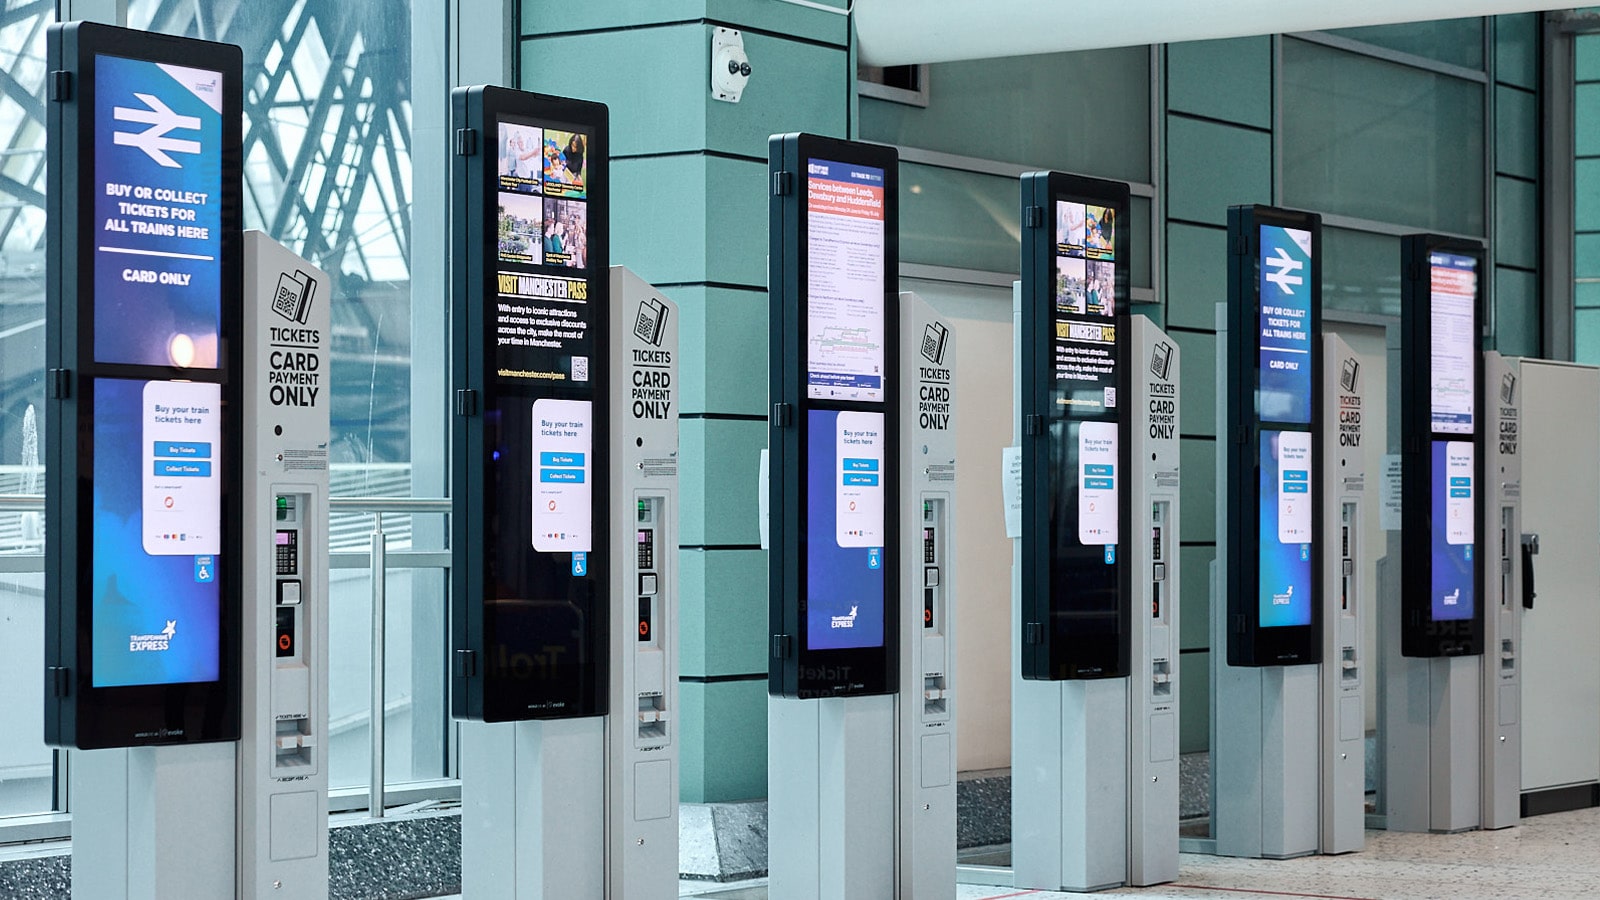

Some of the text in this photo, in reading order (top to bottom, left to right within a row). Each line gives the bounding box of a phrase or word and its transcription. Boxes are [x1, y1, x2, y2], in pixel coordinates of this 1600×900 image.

[106, 183, 207, 204] BUY OR COLLECT
[808, 181, 874, 198] Services between Leeds,
[808, 191, 835, 203] Dewsbury
[848, 197, 881, 208] Huddersfield
[119, 202, 195, 221] TICKETS FOR
[105, 219, 208, 239] ALL TRAINS HERE
[123, 269, 191, 285] CARD ONLY
[498, 275, 586, 300] VISIT MANCHESTER PASS
[498, 304, 511, 312] With
[512, 306, 525, 315] entry
[533, 306, 548, 315] iconic
[549, 309, 577, 317] attractions
[1263, 306, 1305, 317] BUY OR COLLECT
[561, 320, 586, 329] discounts
[1268, 318, 1300, 328] TICKETS FOR
[270, 328, 319, 343] TICKETS
[527, 328, 537, 337] city,
[1102, 326, 1115, 341] PASS
[1263, 329, 1305, 340] ALL TRAINS HERE
[270, 351, 318, 371] CARD
[632, 349, 671, 363] TICKETS
[1270, 360, 1298, 370] CARD ONLY
[270, 372, 318, 385] PAYMENT
[633, 371, 670, 388] CARD
[920, 368, 950, 380] TICKETS
[632, 389, 670, 400] PAYMENT
[920, 386, 949, 402] CARD
[1150, 383, 1174, 394] TICKETS
[270, 386, 318, 406] ONLY
[1340, 396, 1360, 405] TICKETS
[155, 405, 169, 414] Buy
[633, 401, 670, 419] ONLY
[920, 402, 949, 413] PAYMENT
[1150, 400, 1174, 414] CARD
[155, 416, 201, 424] tickets here
[920, 413, 949, 430] ONLY
[1150, 415, 1174, 423] PAYMENT
[1340, 412, 1360, 423] CARD
[1150, 424, 1174, 439] ONLY
[1340, 424, 1360, 432] PAYMENT
[1500, 422, 1517, 433] CARD
[1340, 433, 1360, 447] ONLY
[1500, 442, 1517, 454] ONLY
[130, 642, 168, 651] EXPRESS
